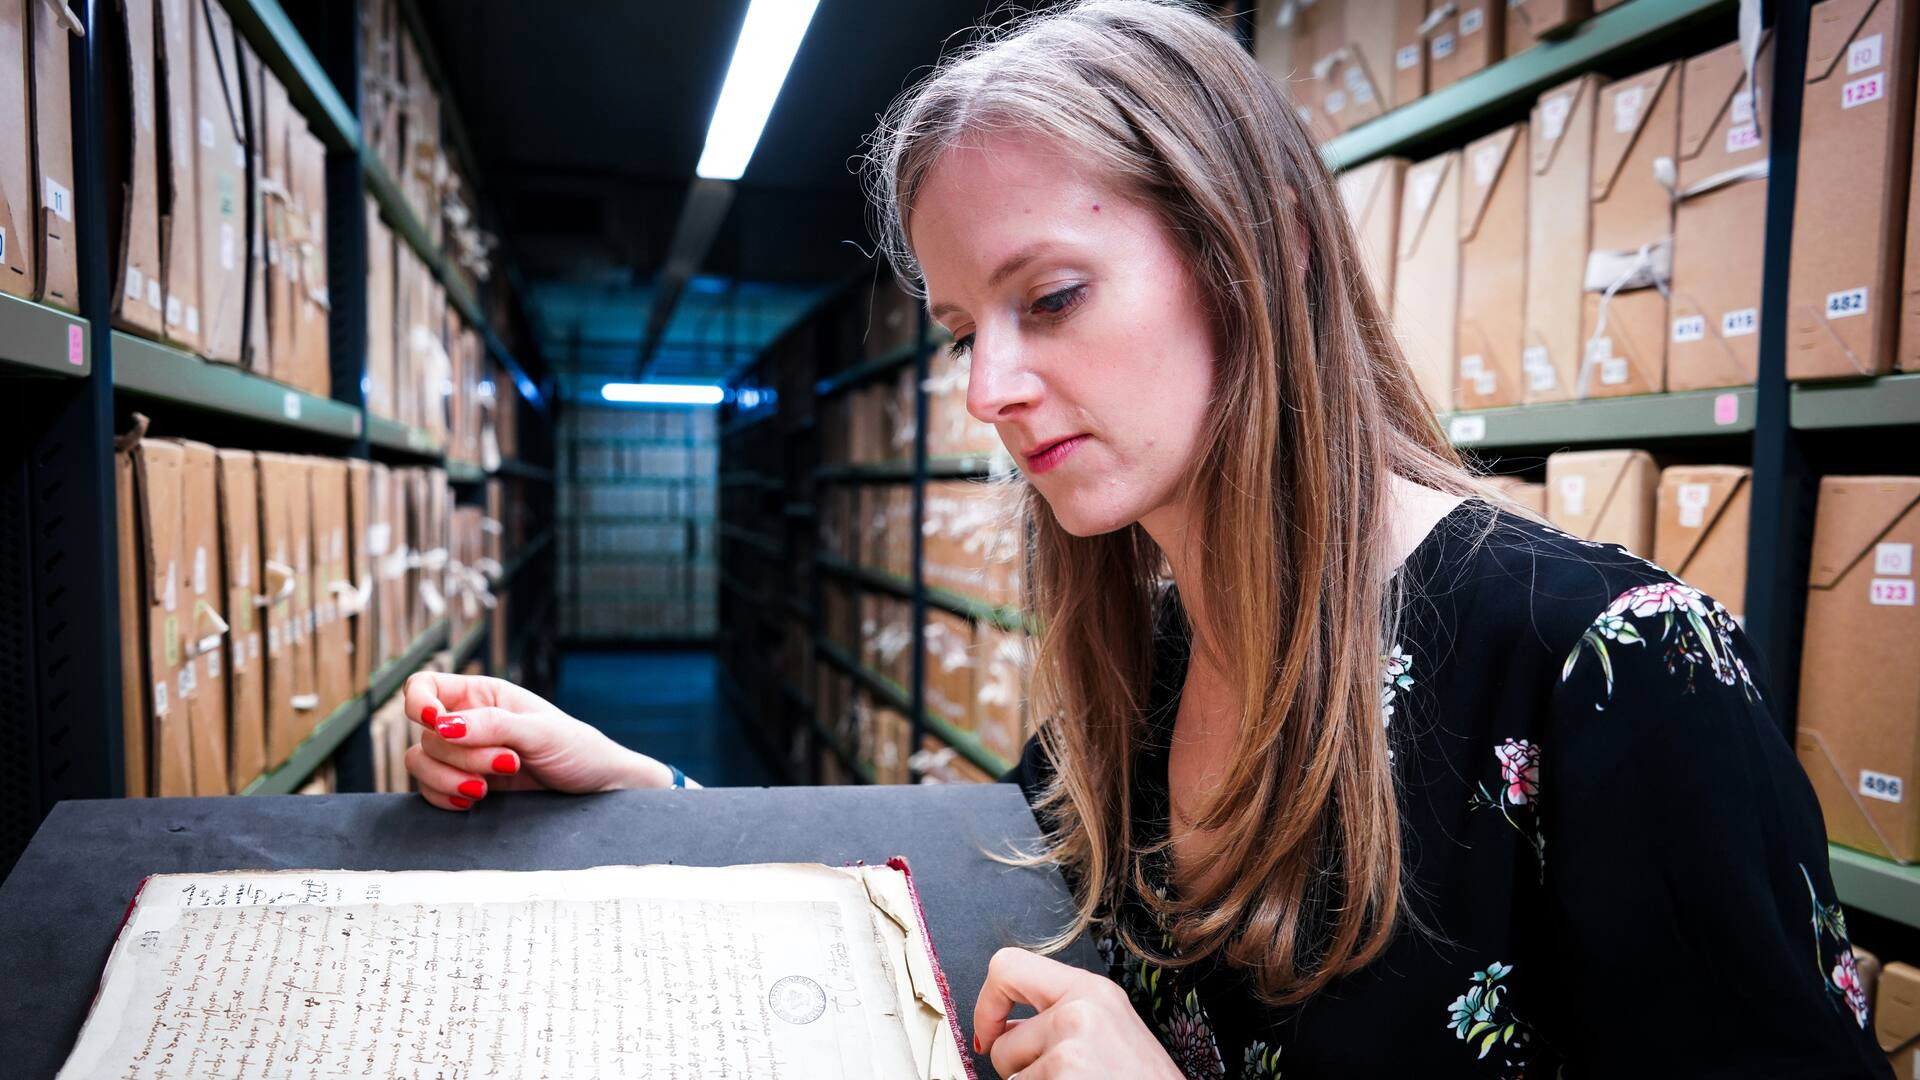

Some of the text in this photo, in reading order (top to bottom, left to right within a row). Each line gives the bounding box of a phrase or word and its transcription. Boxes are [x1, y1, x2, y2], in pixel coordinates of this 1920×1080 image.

[1846, 80, 1877, 103] 123
[1830, 293, 1861, 310] 482
[1874, 583, 1907, 600] 123
[1864, 775, 1899, 796] 496
